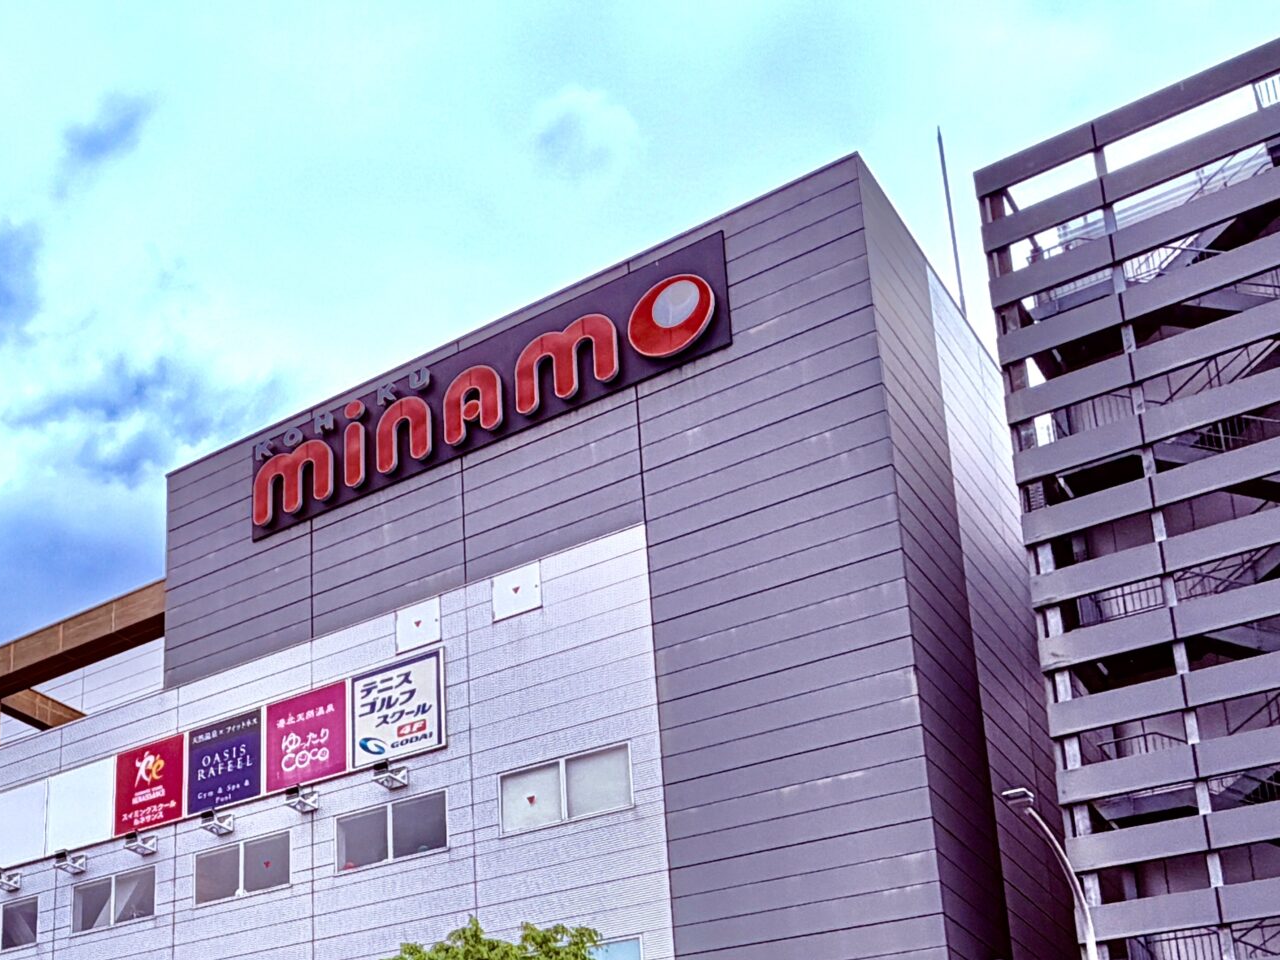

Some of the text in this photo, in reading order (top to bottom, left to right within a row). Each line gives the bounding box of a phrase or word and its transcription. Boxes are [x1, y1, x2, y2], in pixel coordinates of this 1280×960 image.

[360, 671, 412, 699] テニス
[359, 688, 416, 717] ゴルフ
[375, 702, 433, 728] スクール
[281, 728, 329, 753] ゆったり
[390, 731, 433, 748] GODAI
[397, 721, 425, 736] 4F
[197, 755, 253, 781] RAFEEL
[201, 744, 247, 767] OASIS
